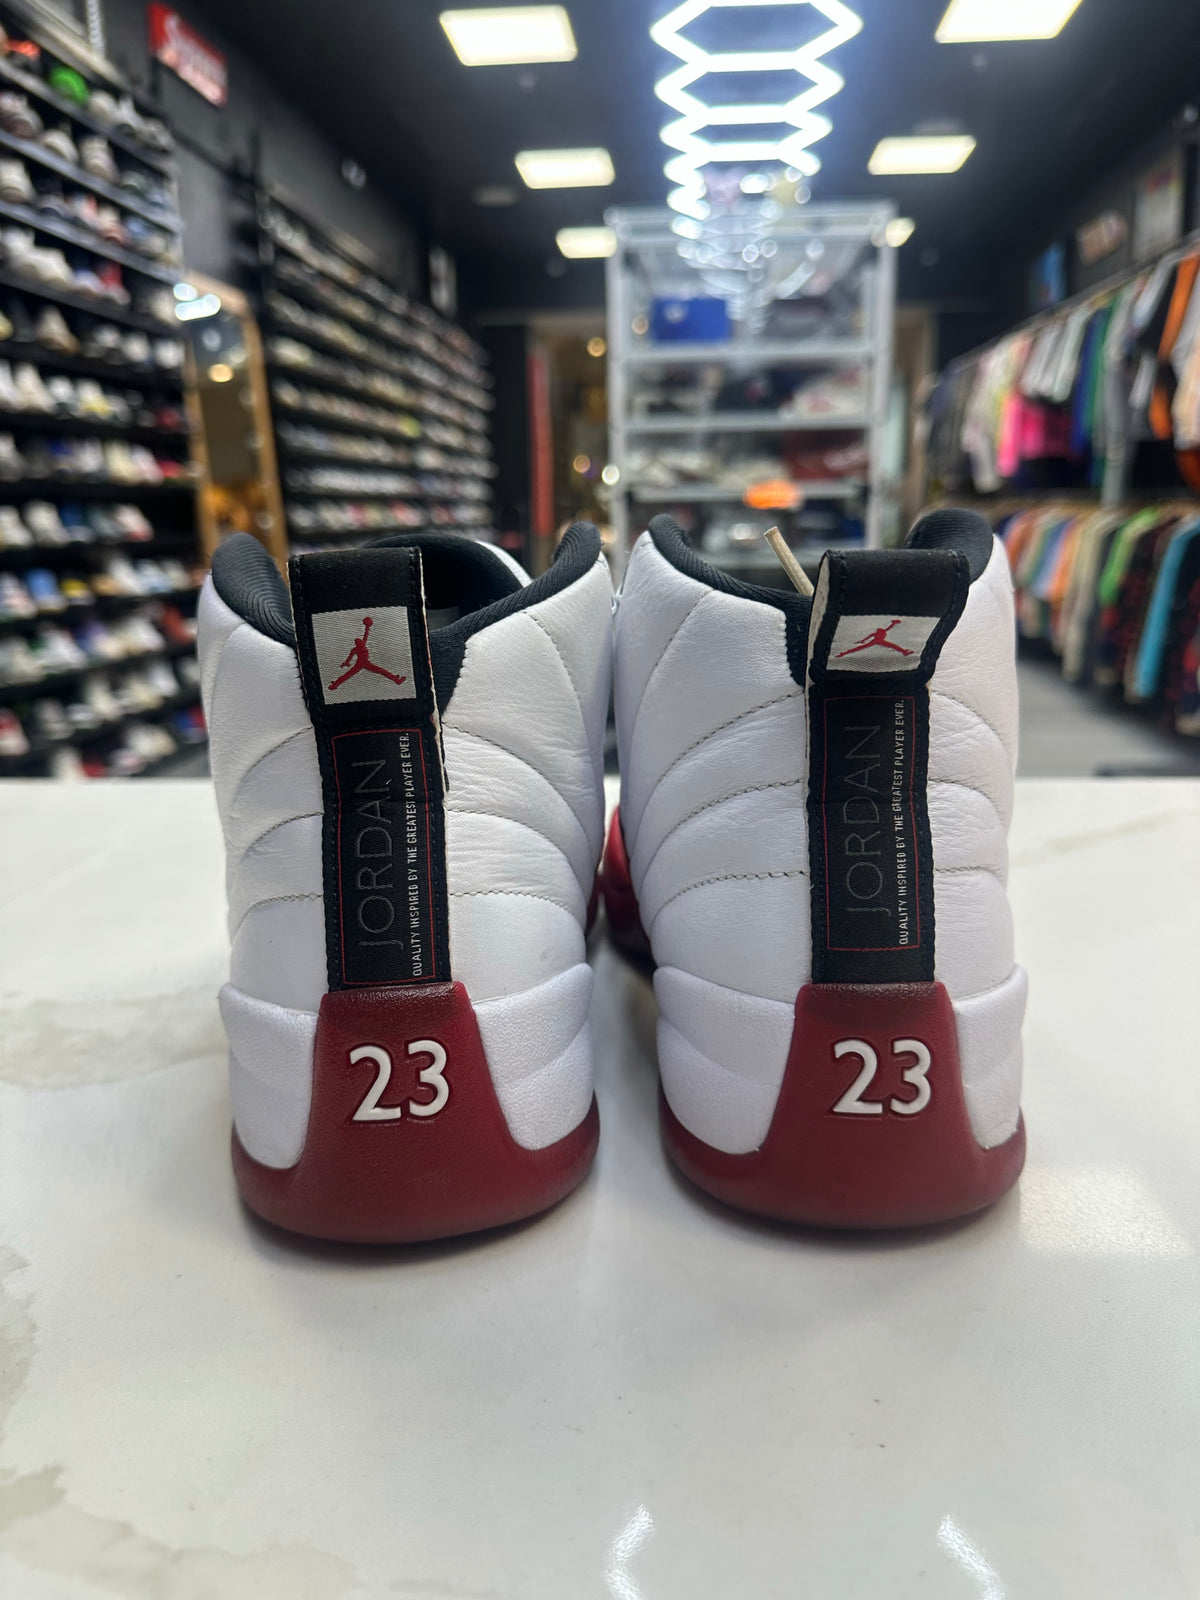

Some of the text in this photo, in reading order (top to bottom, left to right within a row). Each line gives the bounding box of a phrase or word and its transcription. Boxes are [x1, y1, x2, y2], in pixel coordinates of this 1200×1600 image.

[894, 699, 905, 726] EVER.
[894, 729, 904, 766] PLAYER
[843, 726, 891, 917] JORDAN
[894, 815, 904, 832] THE
[896, 837, 906, 850] BY
[352, 759, 404, 949] JORDAN
[400, 732, 423, 976] QUALITY INSPIRED BY THE GREATEST PLAYER EVER.
[897, 852, 908, 896] INSPIRED
[898, 899, 909, 945] QUALITY
[349, 1039, 450, 1121] 23
[832, 1039, 932, 1115] 23
